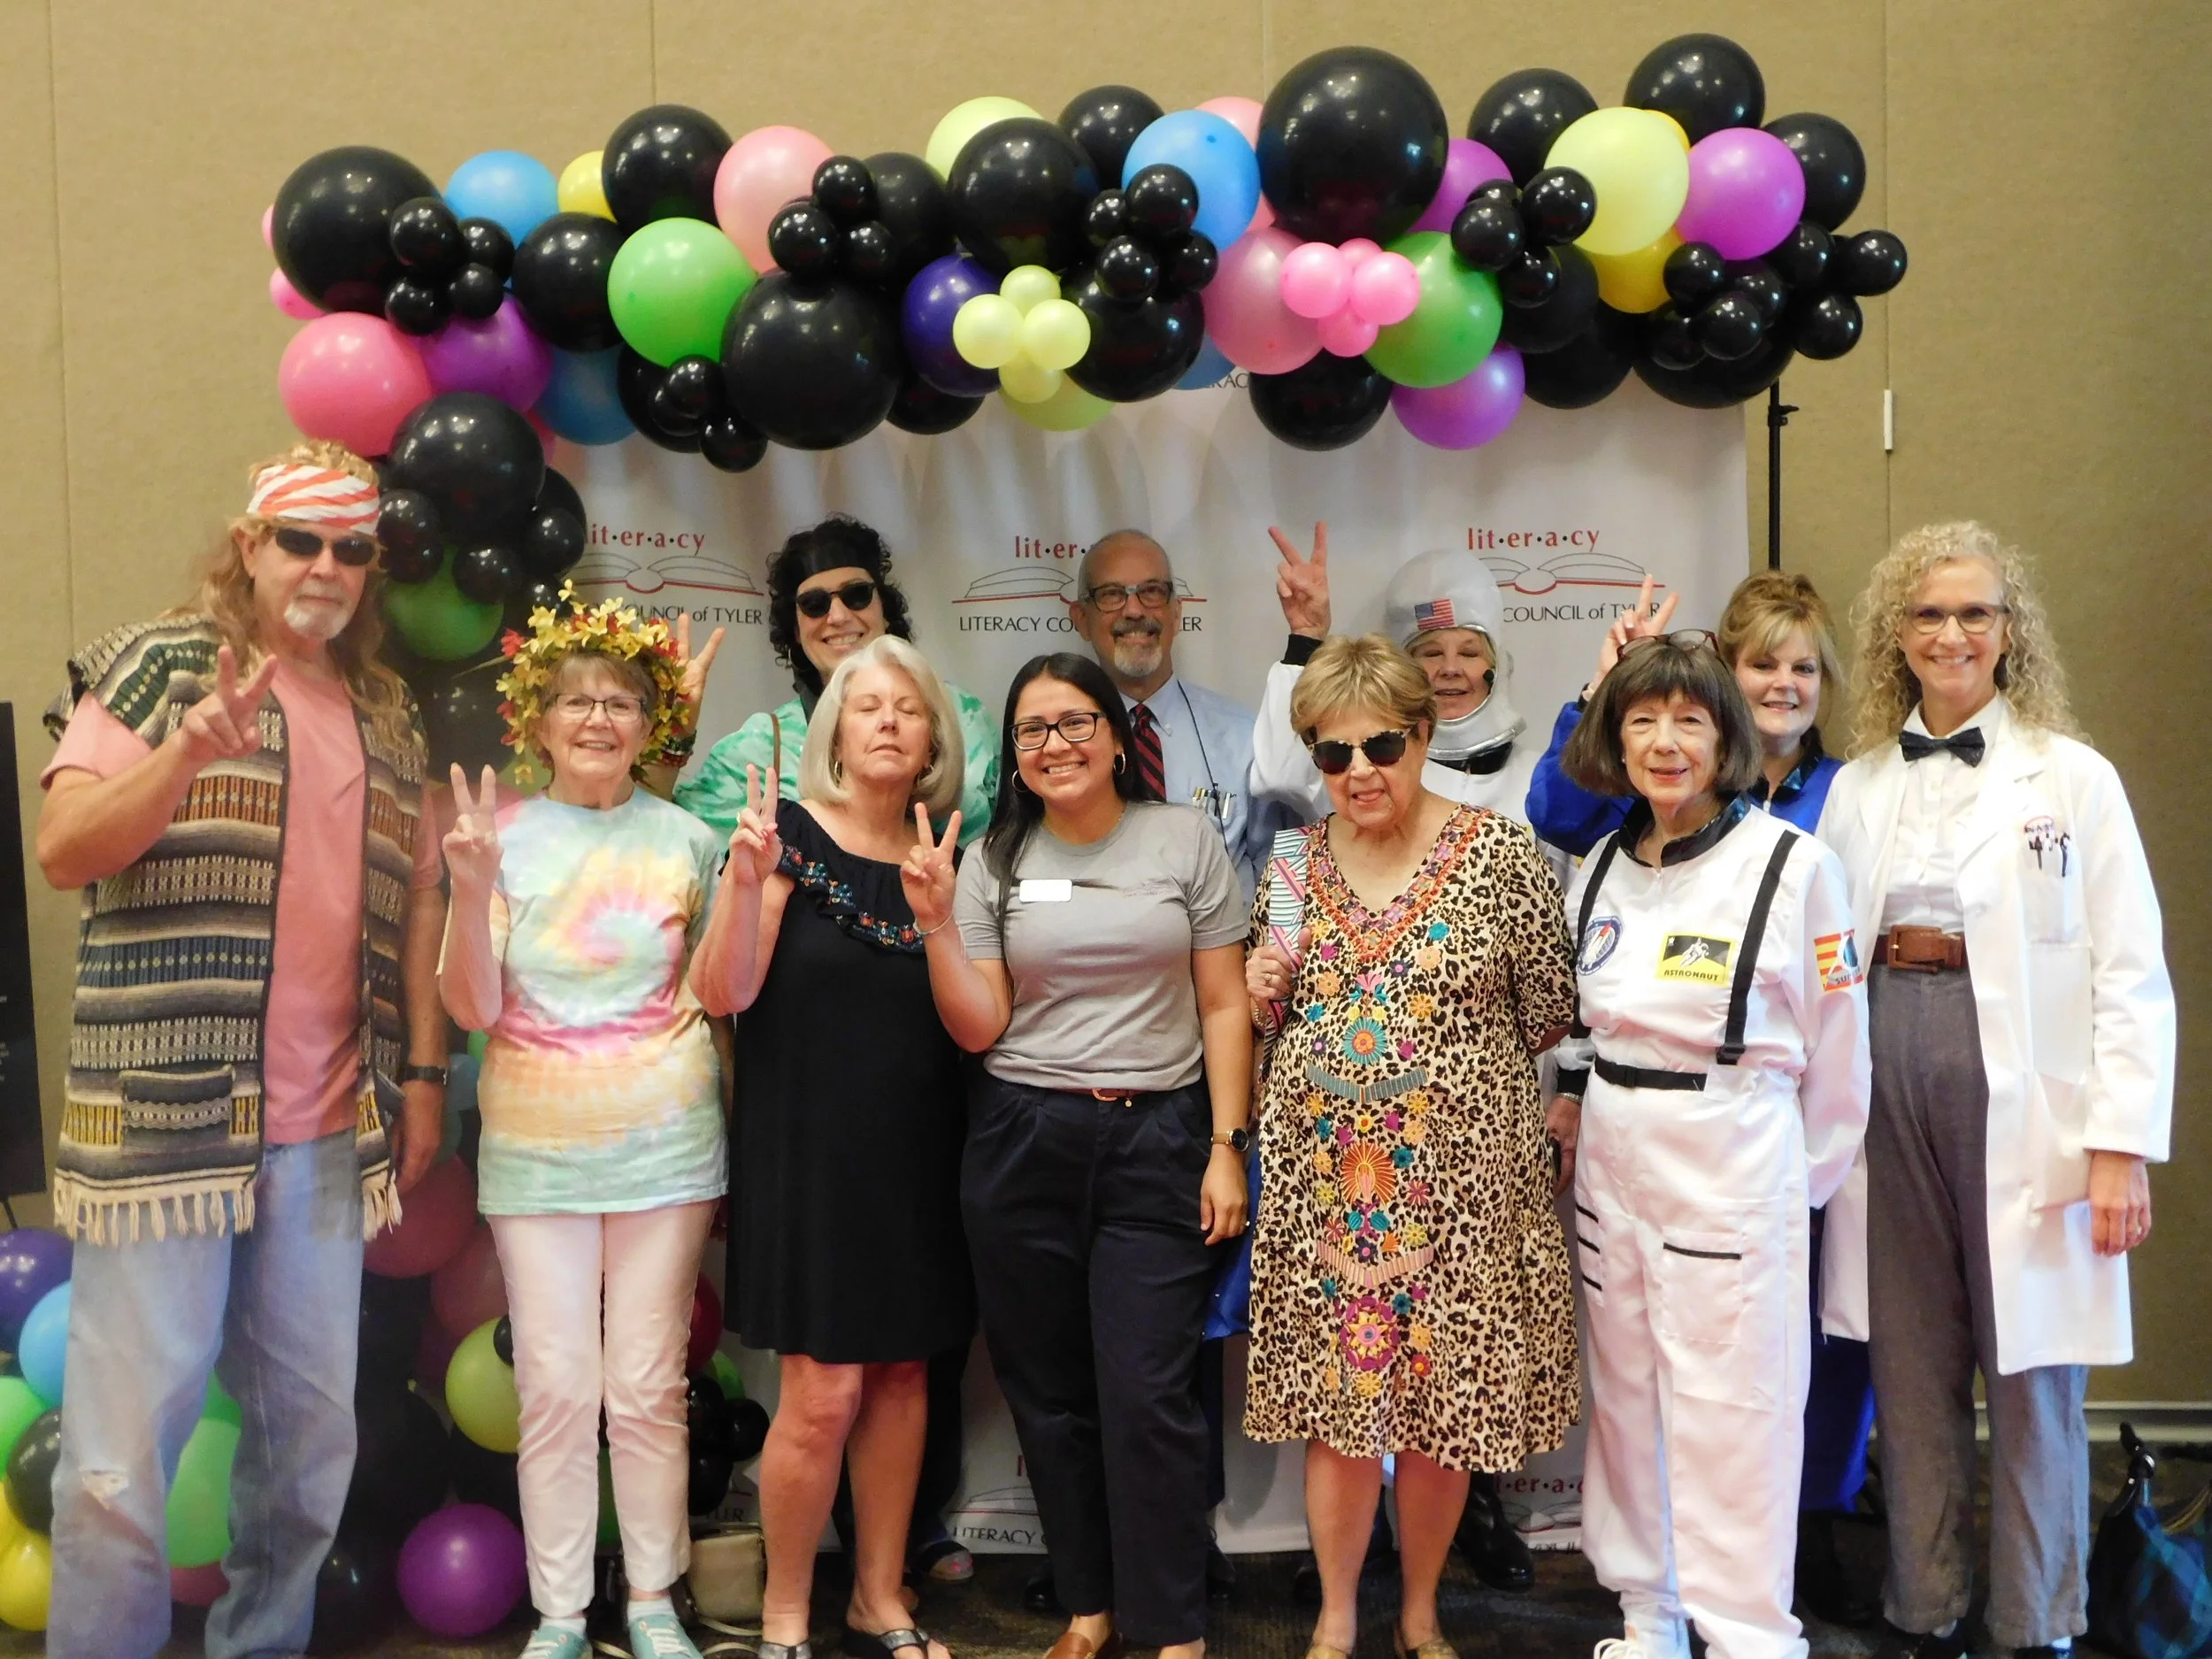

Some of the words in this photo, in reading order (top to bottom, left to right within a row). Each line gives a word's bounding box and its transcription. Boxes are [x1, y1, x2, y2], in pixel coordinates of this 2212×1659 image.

[693, 606, 709, 621] of
[713, 608, 763, 625] TYLER
[1502, 603, 1585, 623] COUNCIL
[1588, 603, 1606, 619] of
[960, 616, 1041, 632] LITERACY
[1663, 969, 1719, 981] ASTRONAUT
[952, 1526, 1037, 1545] LITERACY
